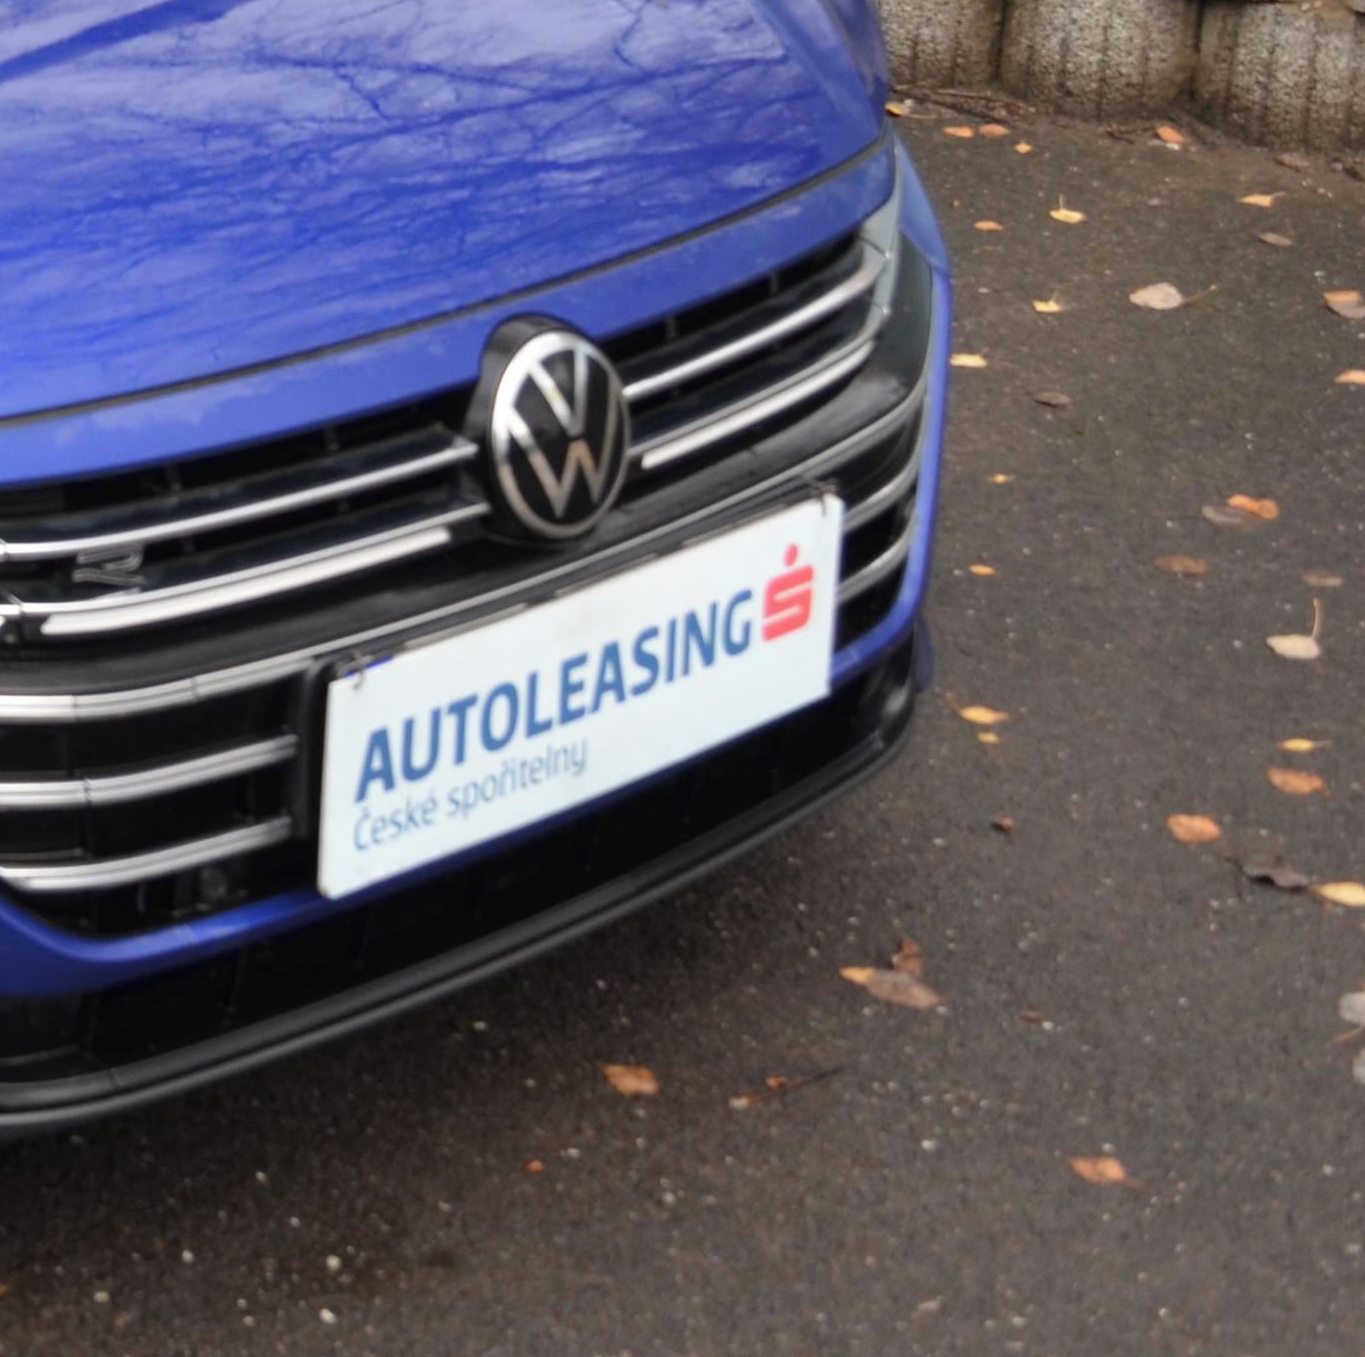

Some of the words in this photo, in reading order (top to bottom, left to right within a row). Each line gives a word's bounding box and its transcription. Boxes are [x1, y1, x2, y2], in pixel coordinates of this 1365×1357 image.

[355, 589, 753, 802] AUTOLEASING
[354, 790, 438, 852] České
[447, 739, 587, 819] spořitelny
